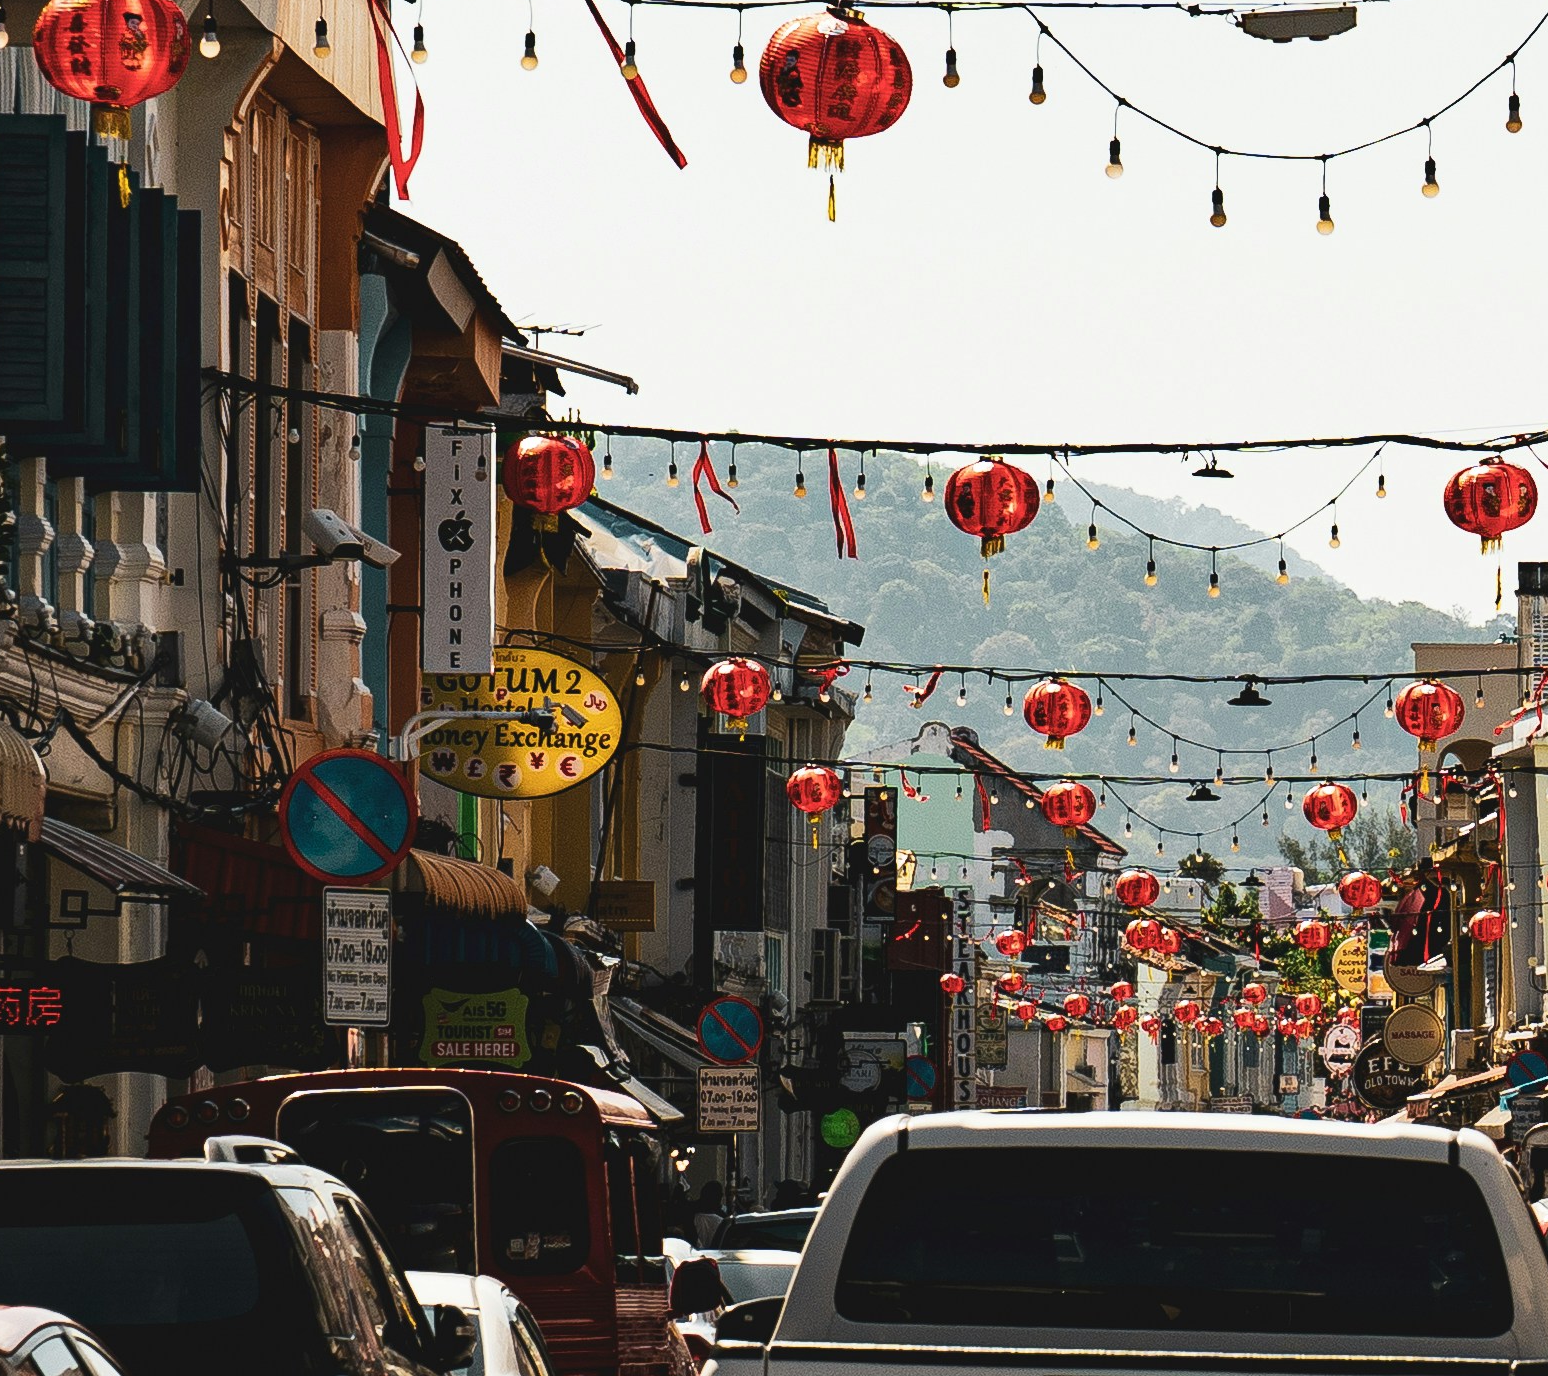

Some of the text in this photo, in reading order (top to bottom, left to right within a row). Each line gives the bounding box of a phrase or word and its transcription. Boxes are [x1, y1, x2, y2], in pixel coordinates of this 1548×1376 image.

[449, 558, 462, 669] PHONE
[436, 667, 583, 695] GOTUM 2
[495, 724, 611, 758] Exchange
[327, 900, 388, 939] ห้ามจอดวันคู่
[327, 938, 388, 965] 07.00-19.00
[327, 971, 387, 988] No Parking Even Days
[956, 887, 972, 1110] STEAKHOUS
[462, 1001, 508, 1018] AIS 5G
[437, 1025, 491, 1039] TOURIST
[1392, 1030, 1435, 1040] MASSAGE
[437, 1042, 516, 1057] SALE HERE!
[1365, 1076, 1383, 1090] OLD
[701, 1090, 757, 1103] 07.00-19.00
[977, 1097, 1025, 1107] CHANGE
